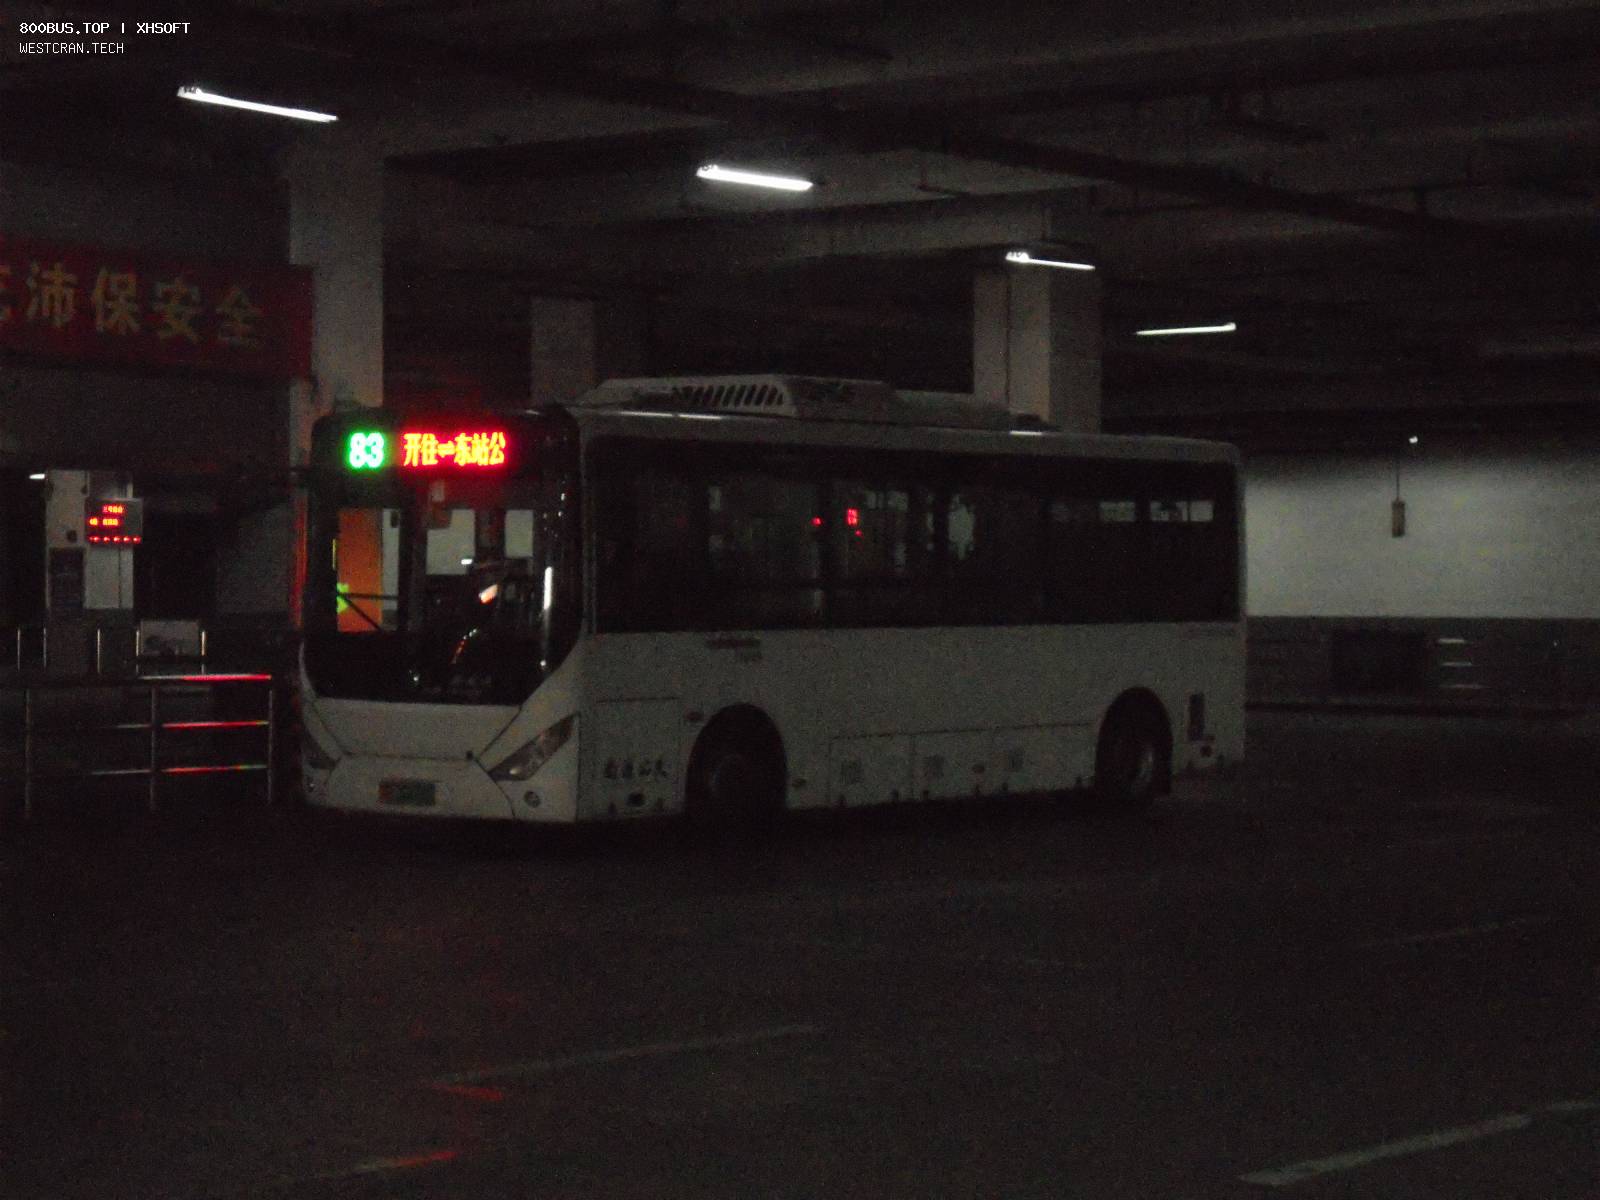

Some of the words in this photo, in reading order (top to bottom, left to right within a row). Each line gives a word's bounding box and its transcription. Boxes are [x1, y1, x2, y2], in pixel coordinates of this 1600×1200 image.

[0, 262, 264, 346] 沛保安全
[348, 431, 385, 469] 83
